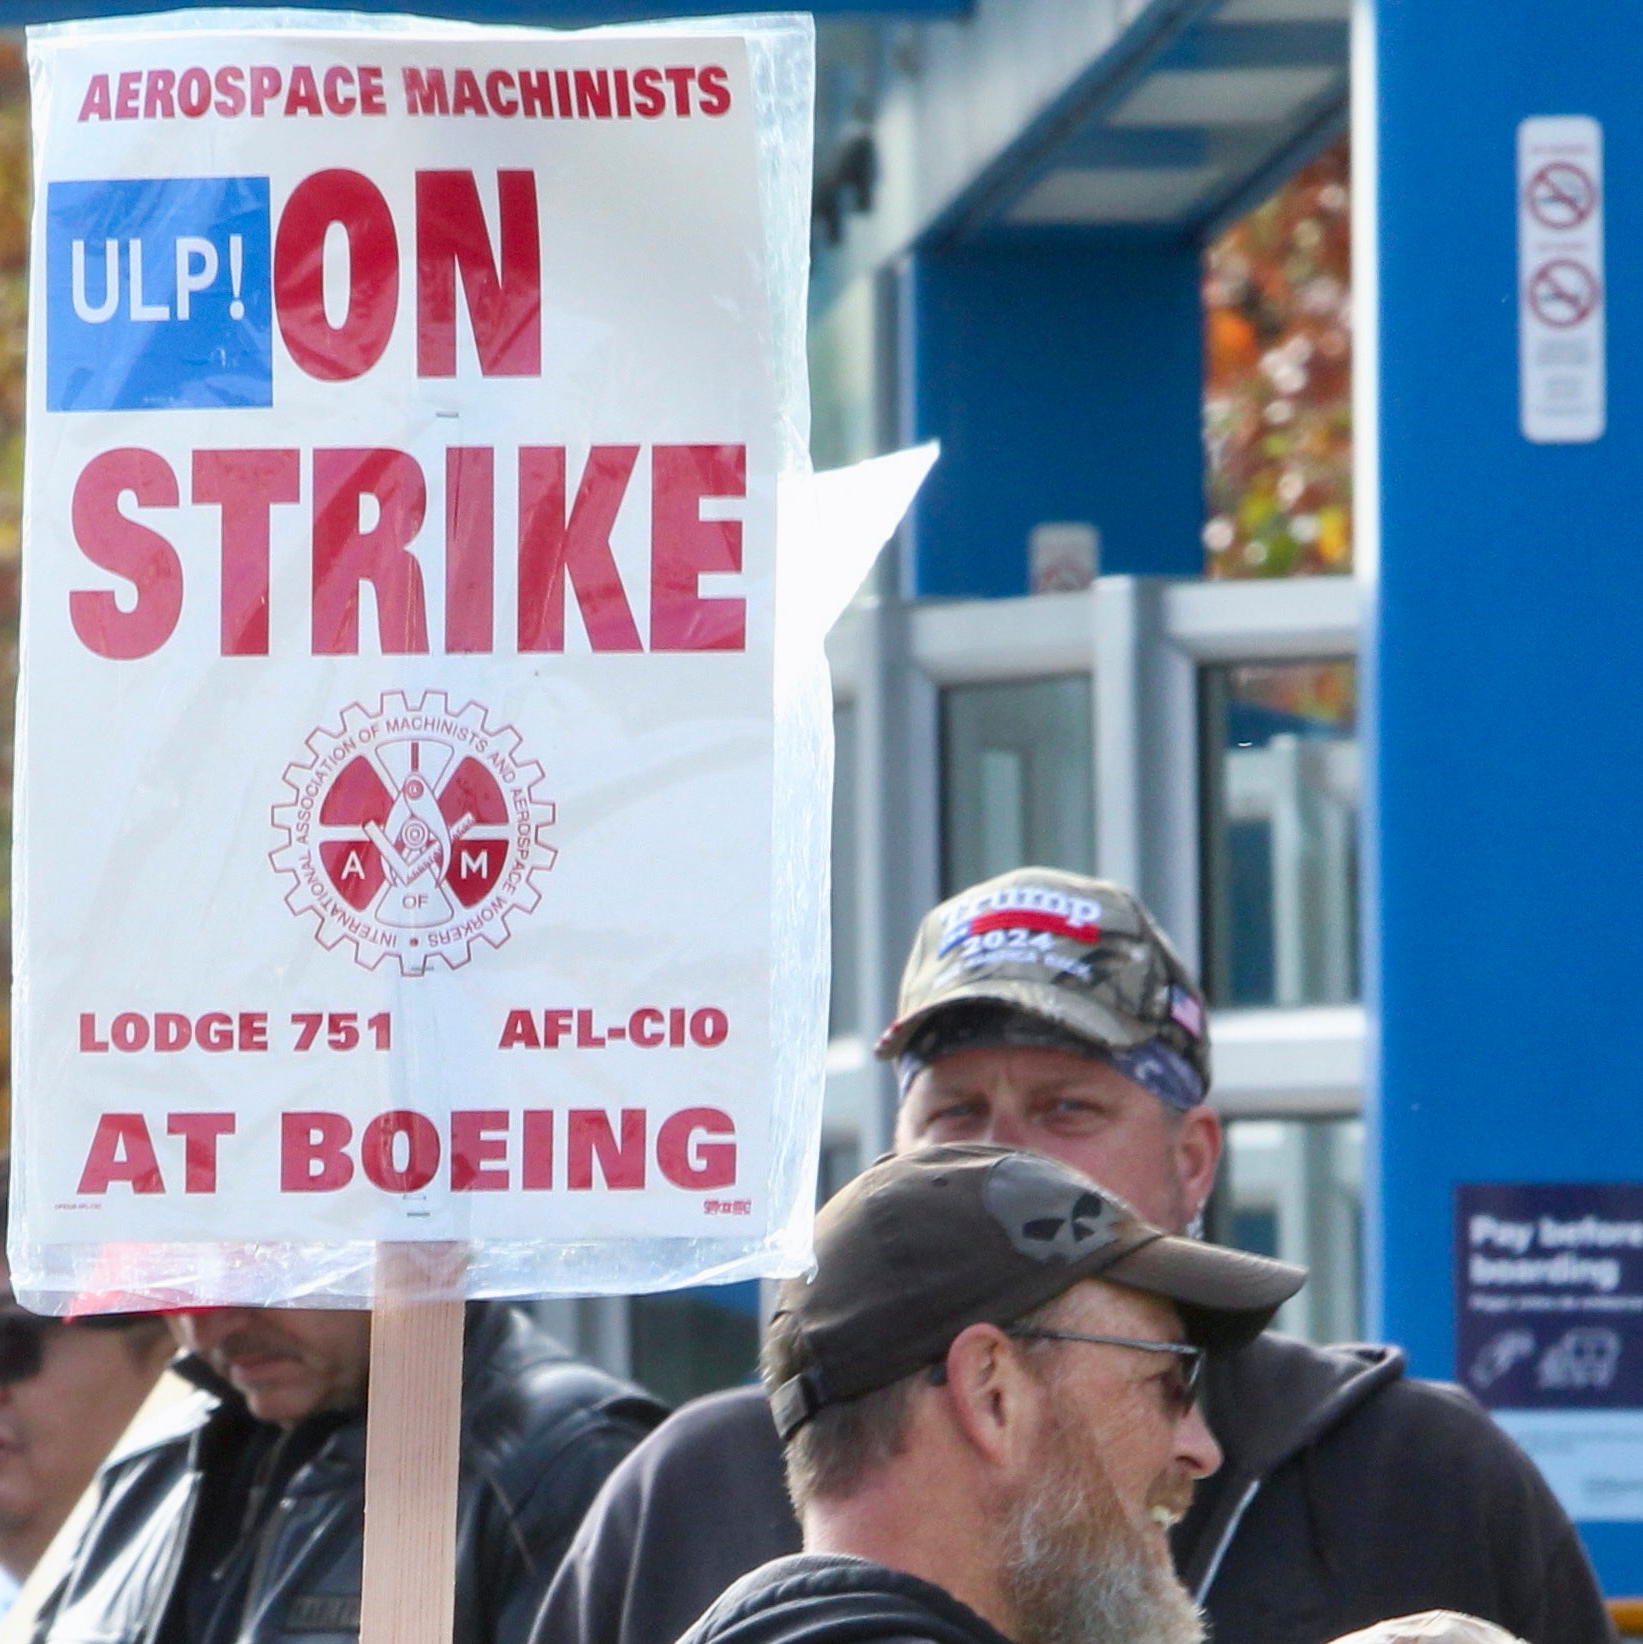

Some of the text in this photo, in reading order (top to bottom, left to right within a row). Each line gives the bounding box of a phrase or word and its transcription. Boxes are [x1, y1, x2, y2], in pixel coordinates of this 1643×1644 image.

[77, 65, 732, 122] AEROSPACE MACHINISTS
[70, 234, 245, 325] ULP!
[273, 166, 543, 382] ON
[68, 443, 747, 662] STRIKE
[296, 716, 532, 948] INTERNATIONAL ASSOCIATION OF MACHINISTS AND AEROSPACE WORKERS
[402, 894, 429, 910] OF
[959, 926, 1055, 961] 2024
[79, 1011, 392, 1054] LODGE 751
[499, 1007, 730, 1050] AFL-CIO
[76, 1106, 738, 1195] AT BOEING
